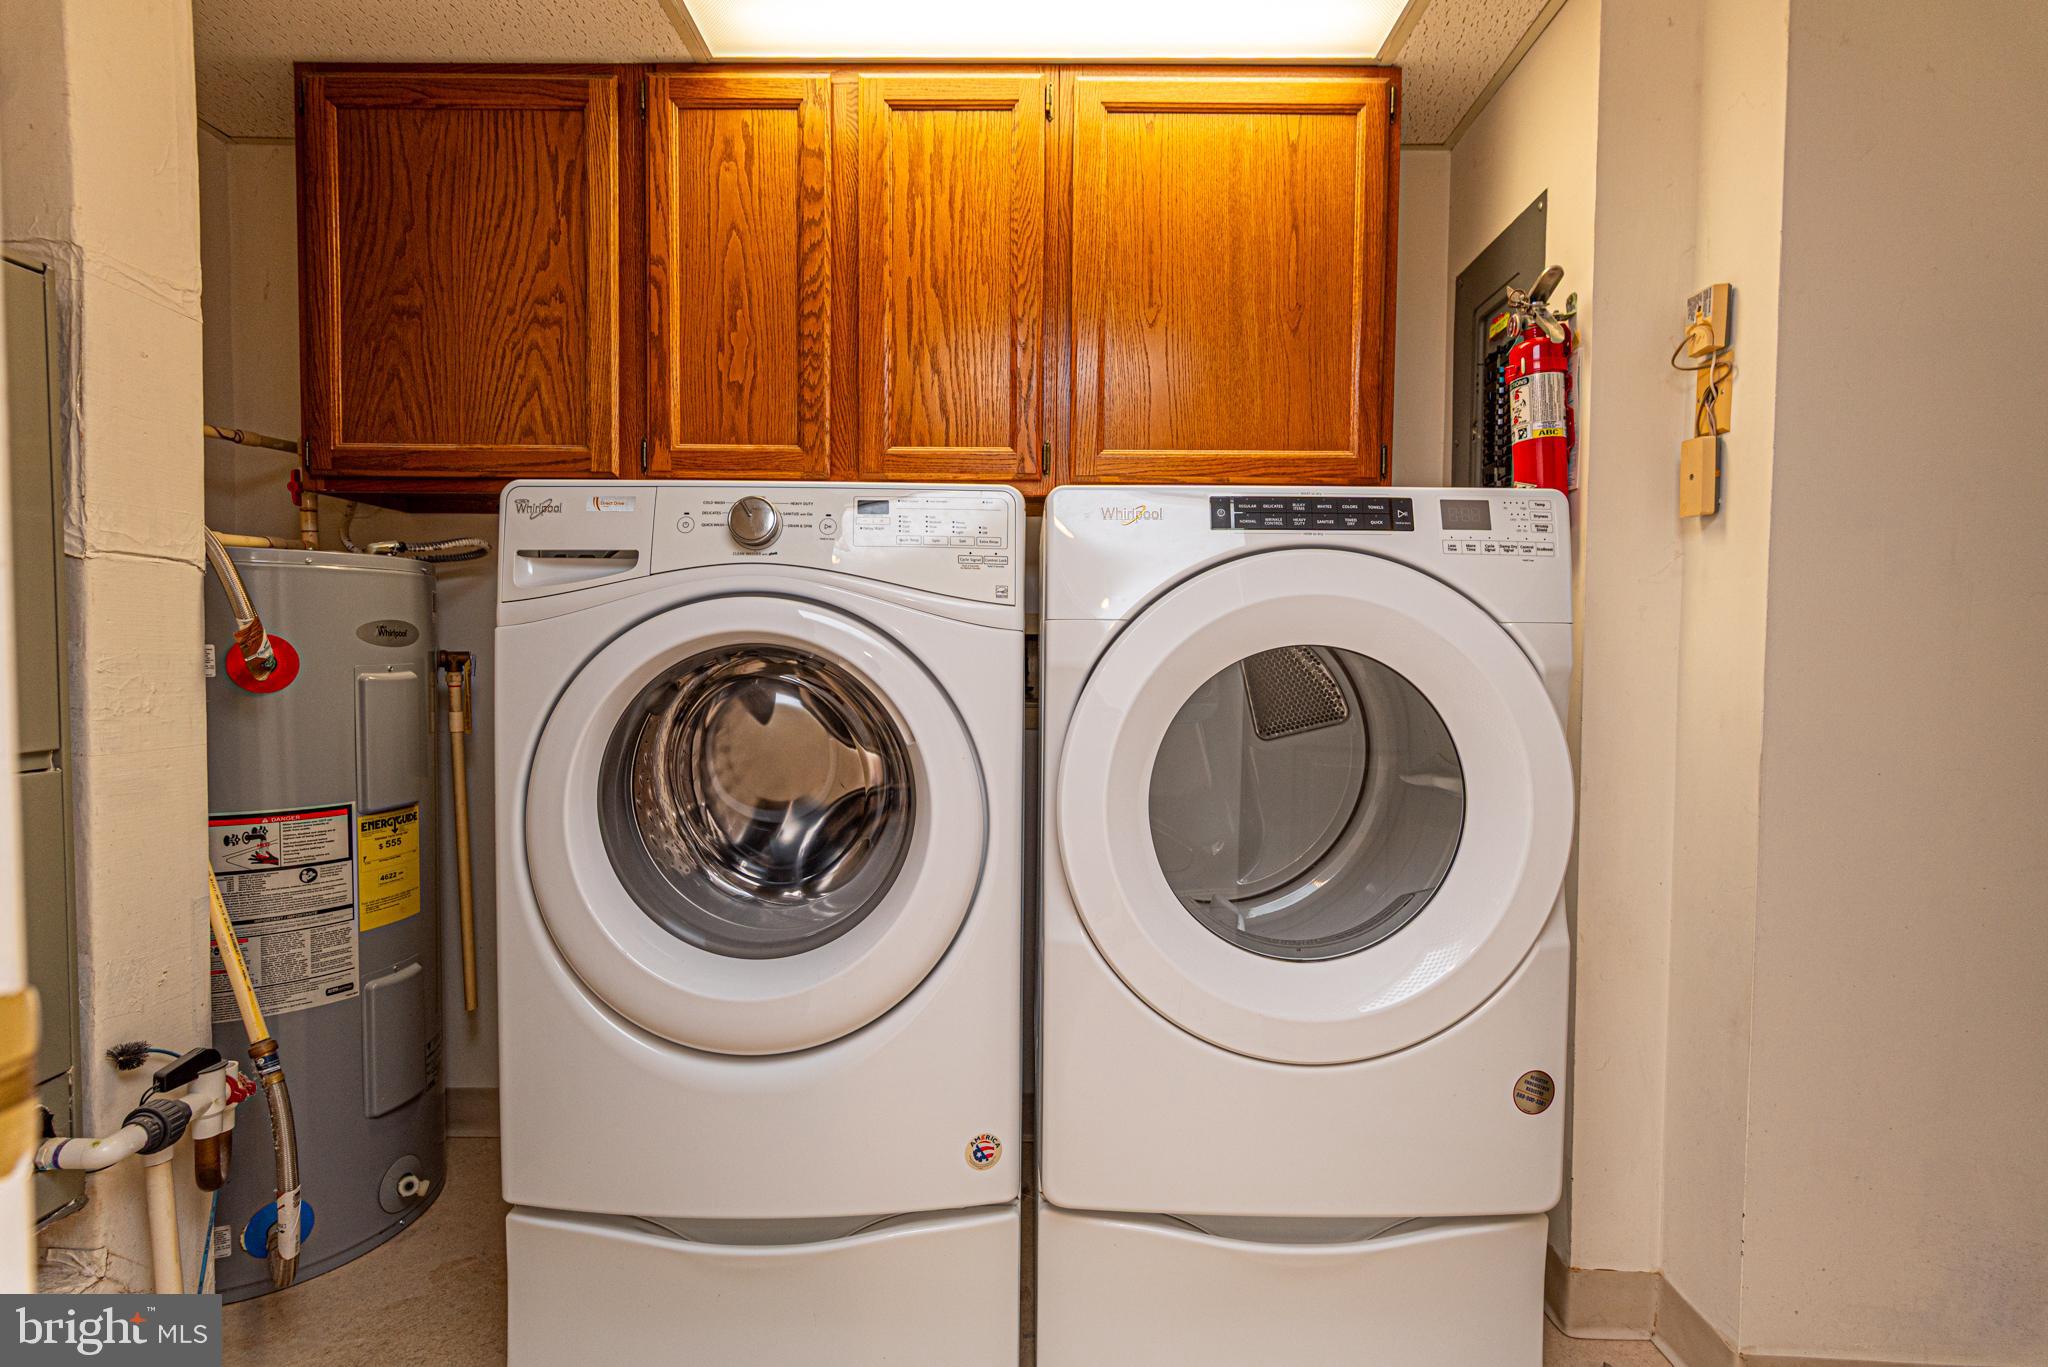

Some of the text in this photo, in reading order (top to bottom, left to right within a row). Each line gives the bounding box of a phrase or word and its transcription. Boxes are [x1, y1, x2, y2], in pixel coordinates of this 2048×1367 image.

[515, 499, 562, 519] Whirlpool
[1101, 504, 1163, 525] Whirlpool
[377, 625, 408, 639] Whirlpool
[271, 815, 301, 823] DANGER
[361, 812, 418, 832] ENERGYGUIDE
[385, 837, 402, 848] 555
[380, 871, 397, 881] 4622
[970, 1134, 1000, 1148] AMERICA
